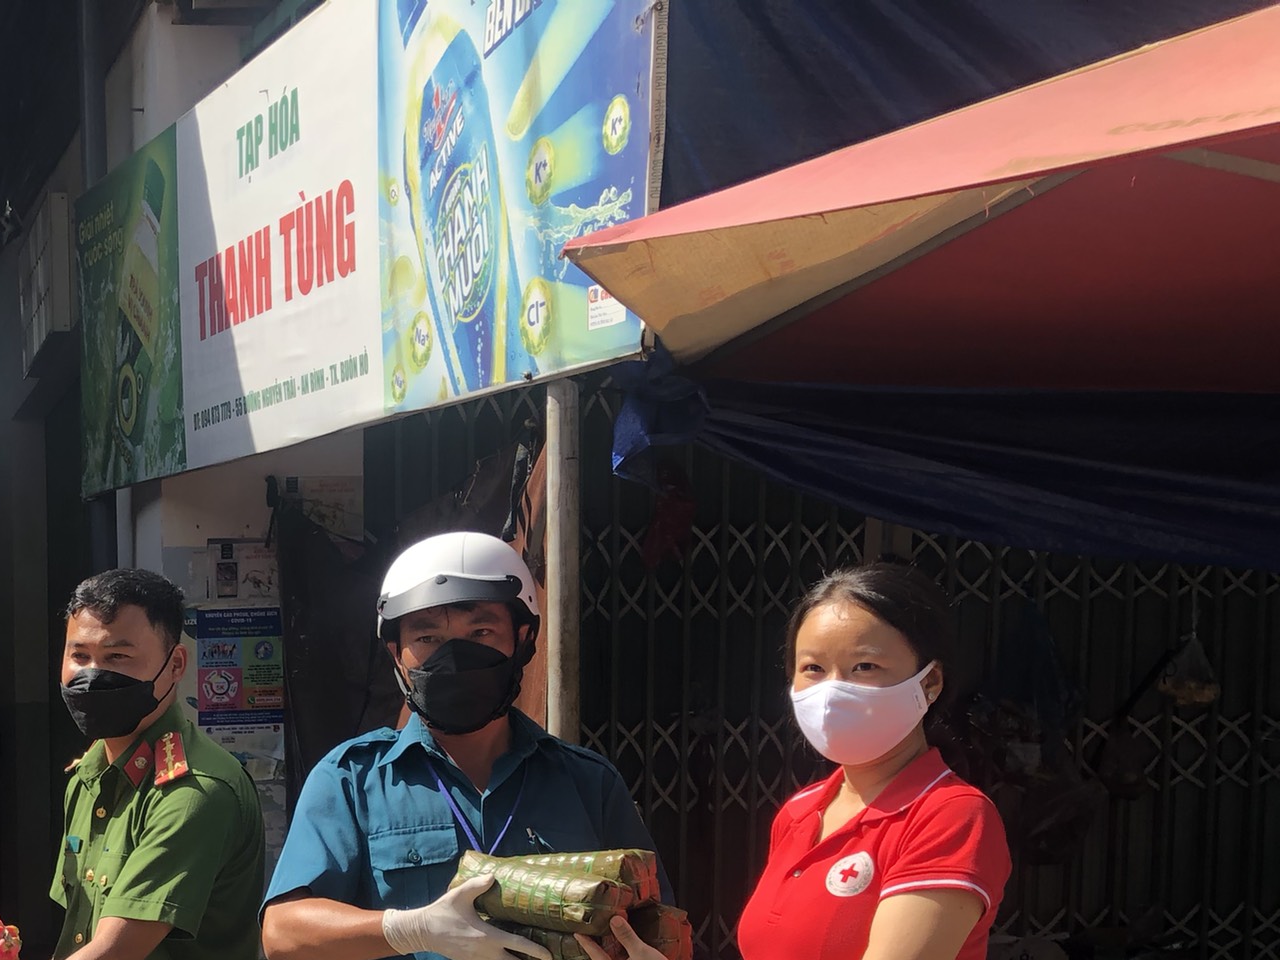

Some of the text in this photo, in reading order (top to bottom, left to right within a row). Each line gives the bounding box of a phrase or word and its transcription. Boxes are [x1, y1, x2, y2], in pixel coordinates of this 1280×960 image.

[236, 85, 300, 183] TẠP HÓA
[429, 105, 464, 197] ACTIVE
[194, 224, 272, 342] THANH
[279, 179, 356, 302] TÙNG
